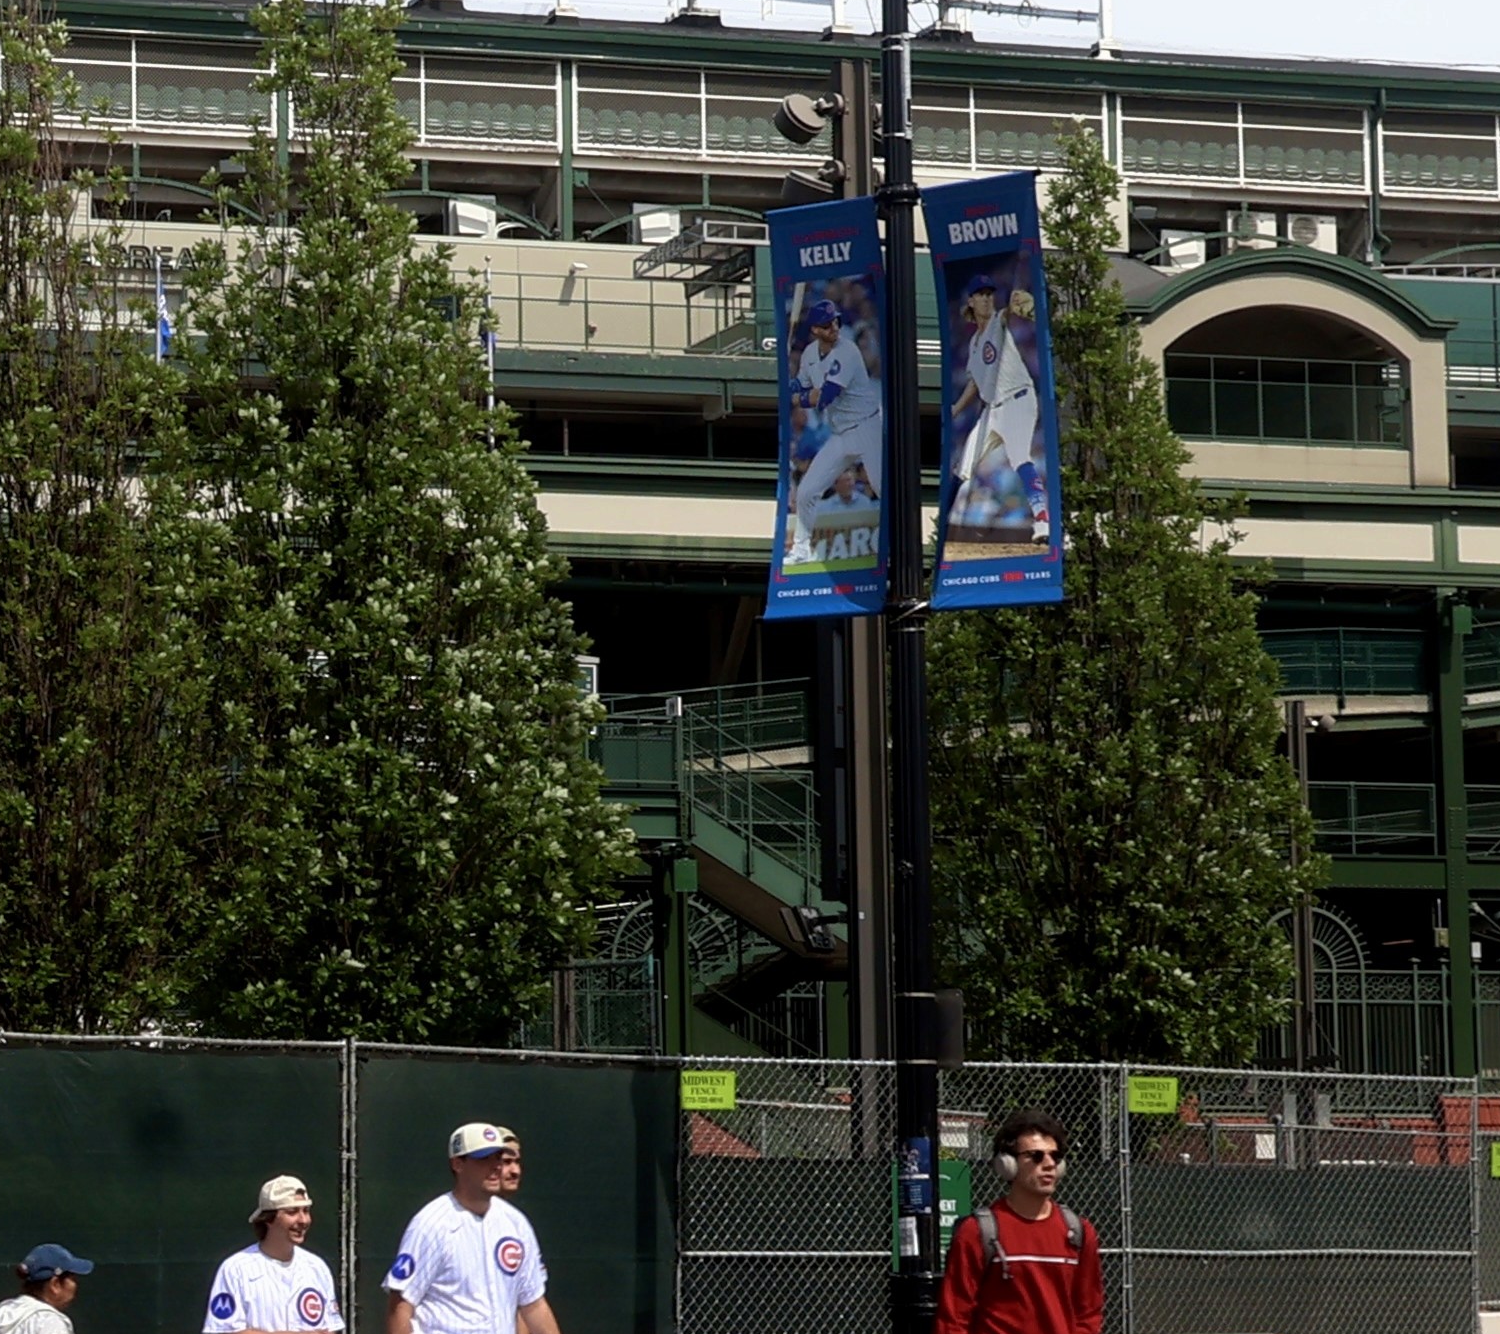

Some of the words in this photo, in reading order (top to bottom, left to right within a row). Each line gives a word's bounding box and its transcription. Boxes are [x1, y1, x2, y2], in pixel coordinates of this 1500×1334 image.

[949, 213, 1018, 245] BROWN
[799, 241, 852, 268] KELLY
[942, 575, 978, 586] CHICAGO
[979, 574, 1000, 584] CUBS
[1024, 570, 1051, 580] YEARS
[777, 587, 811, 598] CHICAGO
[813, 587, 833, 596] CUBS
[854, 584, 878, 593] YEARS
[682, 1075, 727, 1086] MIDWEST
[690, 1086, 717, 1096] FENCE
